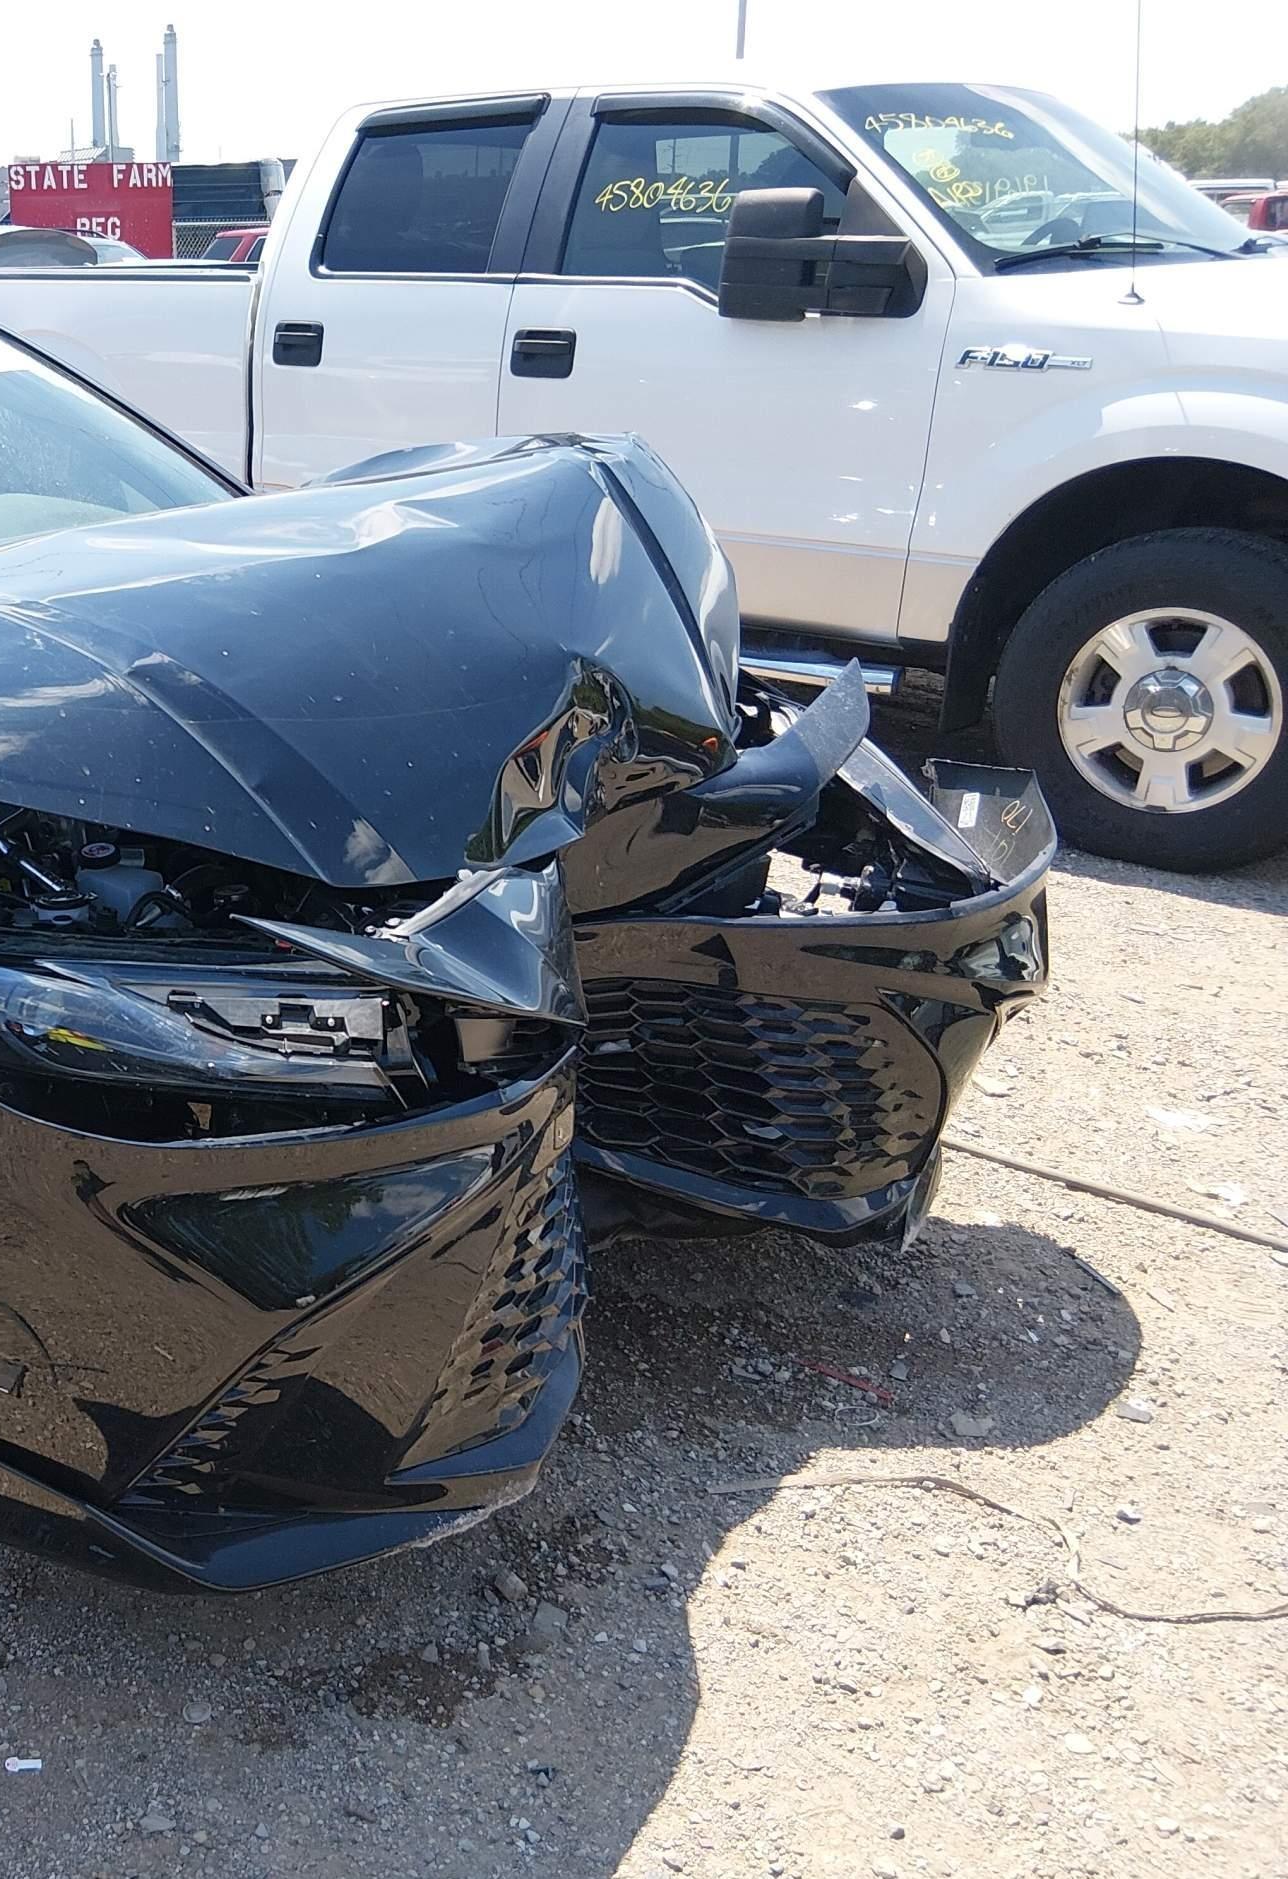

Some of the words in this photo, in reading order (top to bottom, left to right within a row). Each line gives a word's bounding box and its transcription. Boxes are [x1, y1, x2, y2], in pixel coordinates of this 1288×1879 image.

[9, 165, 88, 190] STATE
[112, 163, 172, 188] FARM
[594, 176, 733, 213] 45804636
